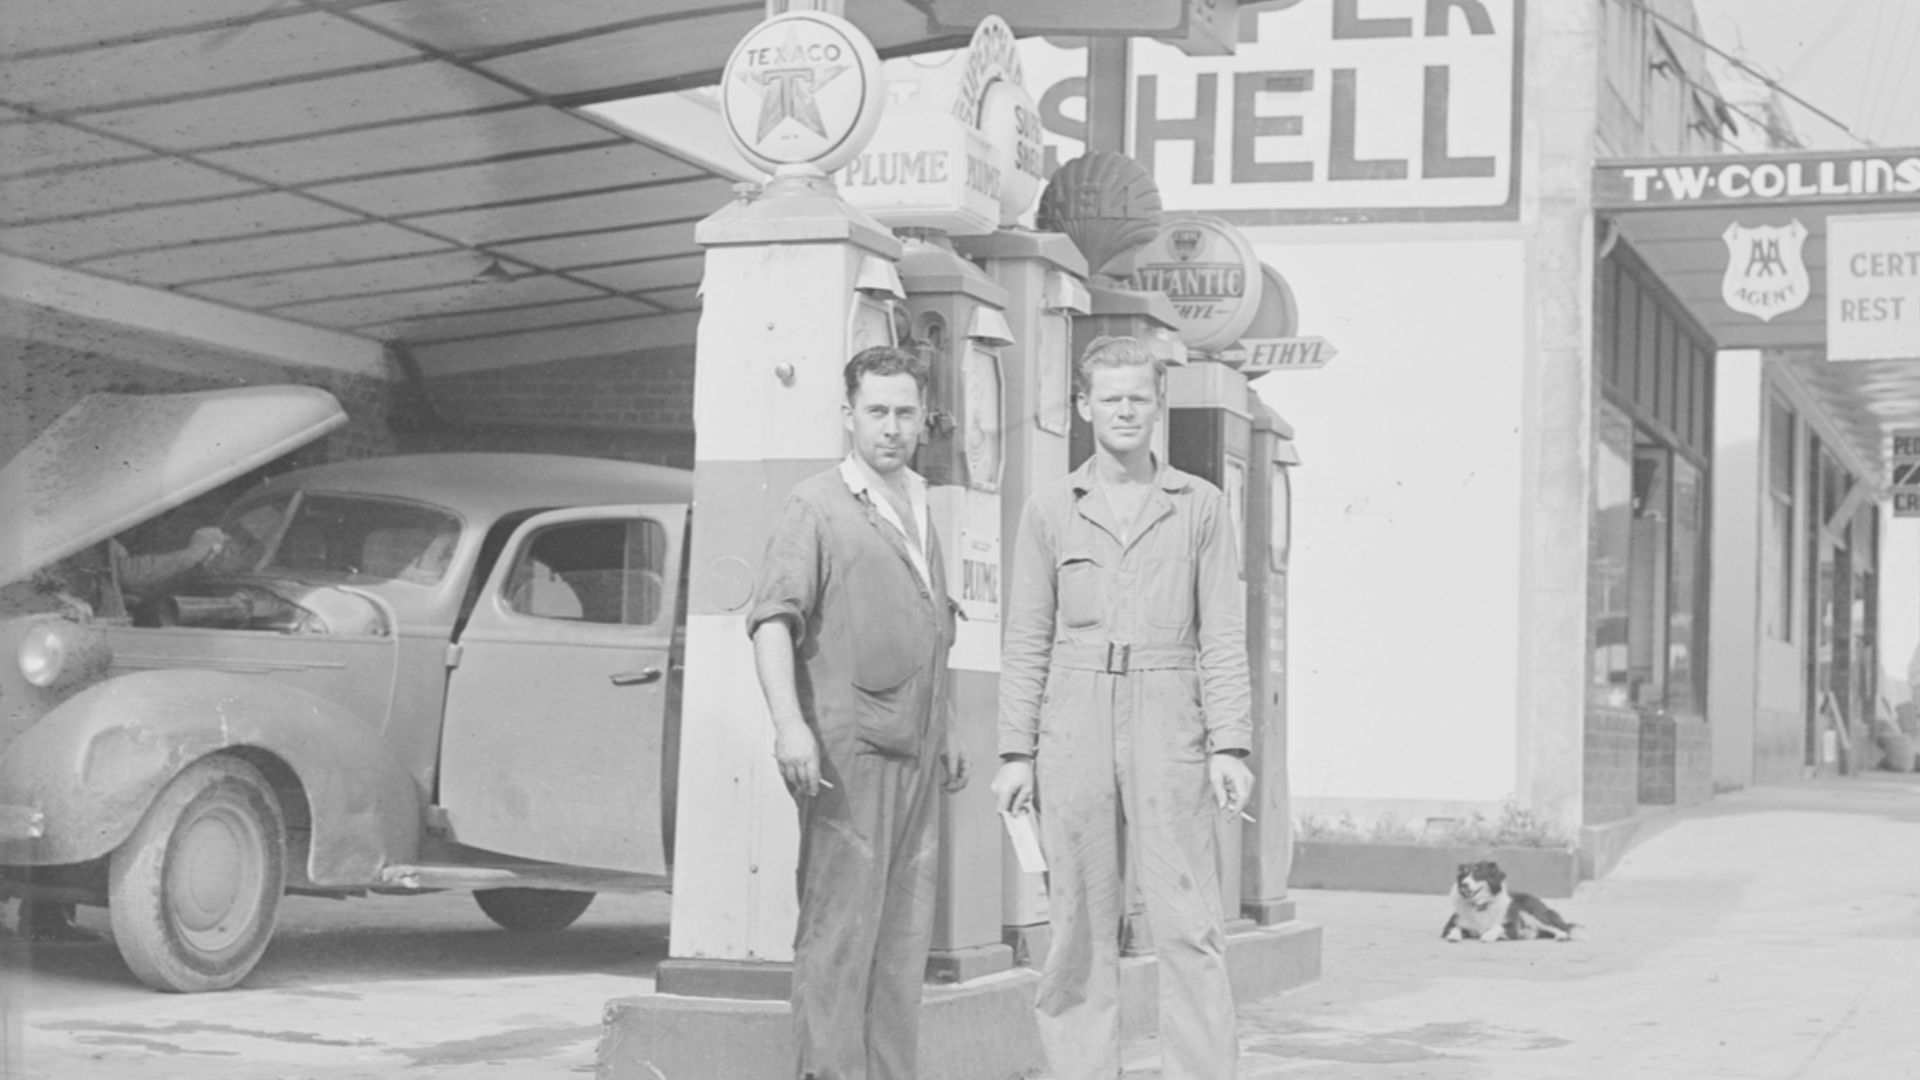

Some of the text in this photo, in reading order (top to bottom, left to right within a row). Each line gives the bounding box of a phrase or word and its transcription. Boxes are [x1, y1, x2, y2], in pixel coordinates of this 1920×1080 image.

[747, 43, 841, 67] TEXACO
[844, 150, 949, 186] PLUME
[1850, 252, 1920, 278] CERT
[1733, 283, 1795, 306] AGENT
[1841, 298, 1905, 323] REST
[1251, 342, 1323, 366] ETHYL
[963, 559, 997, 604] PLUME
